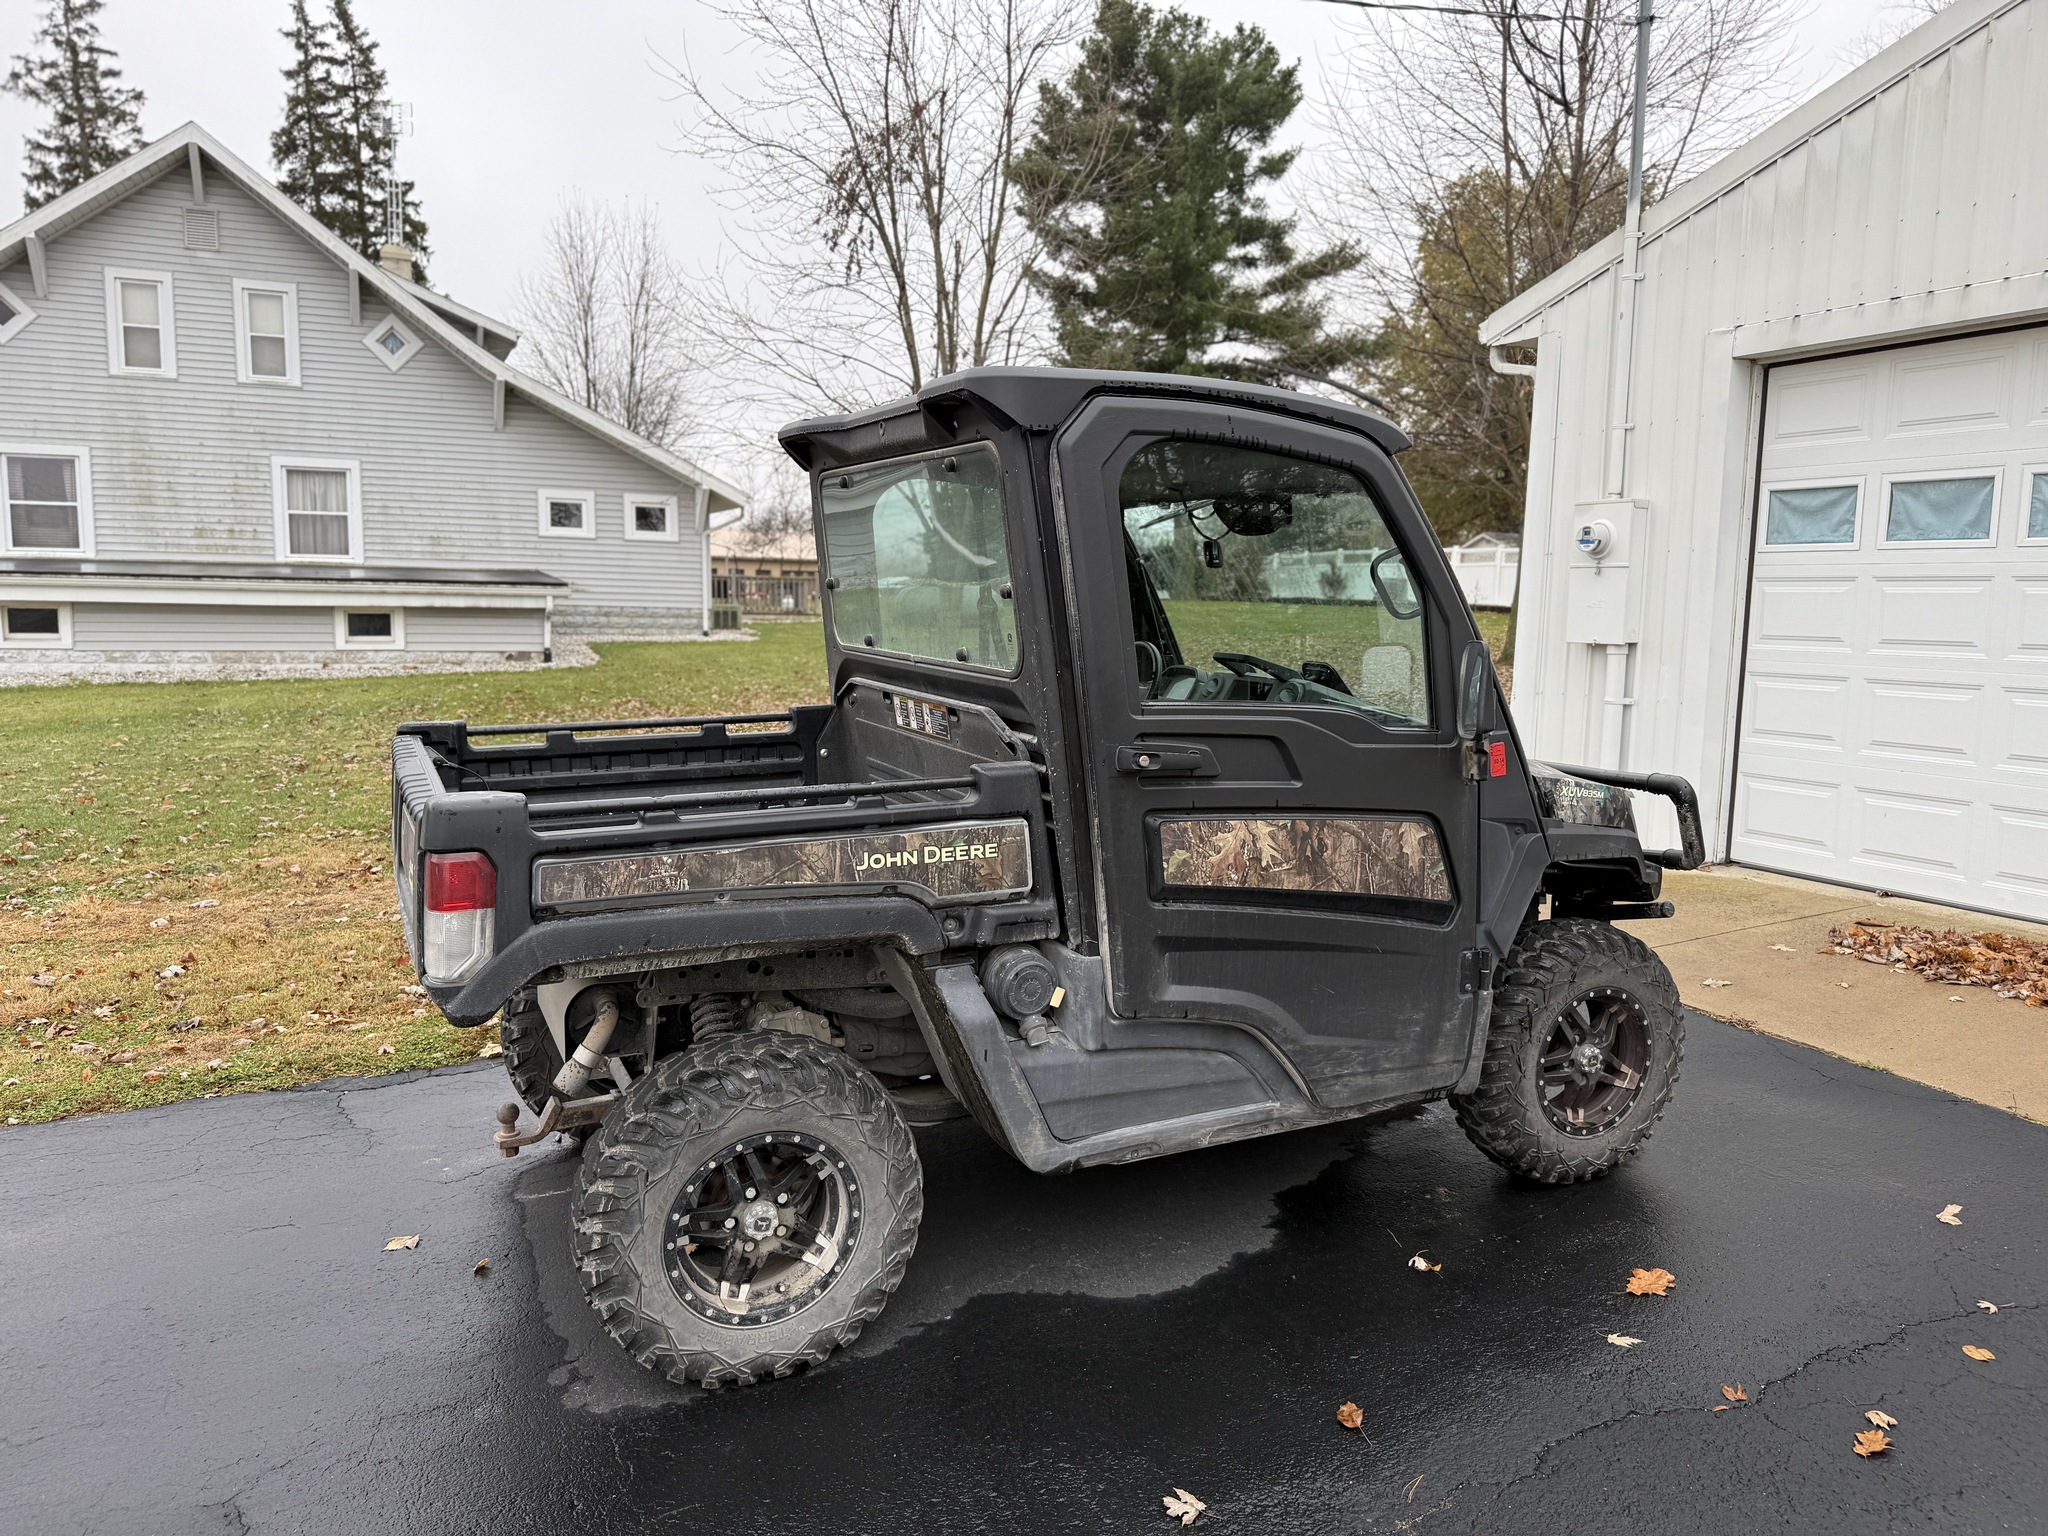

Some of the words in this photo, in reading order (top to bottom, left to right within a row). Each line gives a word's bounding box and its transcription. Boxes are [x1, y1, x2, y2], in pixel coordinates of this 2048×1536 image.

[1560, 785, 1604, 799] XUV835M
[855, 849, 919, 871] JOHN
[923, 842, 999, 864] DEERE
